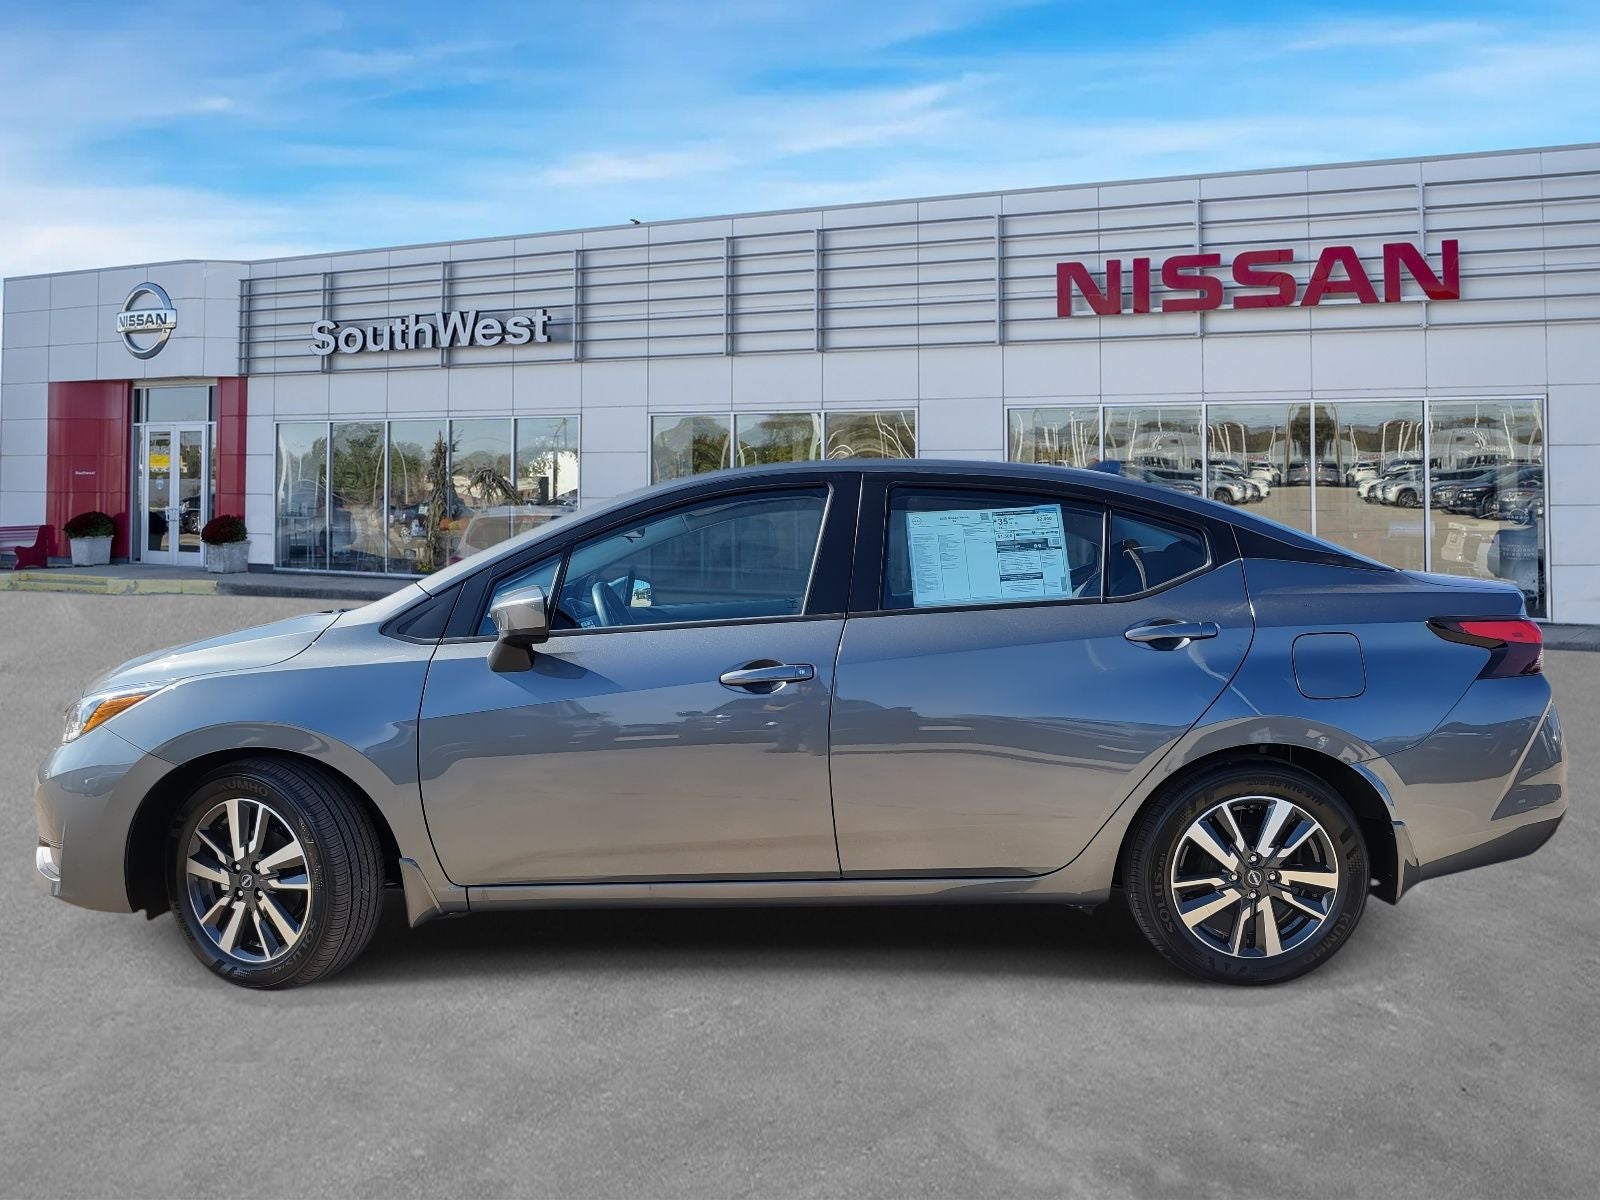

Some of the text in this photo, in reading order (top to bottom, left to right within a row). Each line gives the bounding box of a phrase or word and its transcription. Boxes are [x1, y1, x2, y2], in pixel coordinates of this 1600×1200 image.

[1057, 239, 1460, 318] NISSAN
[119, 312, 167, 328] NISSAN
[308, 309, 552, 356] SouthWest
[997, 517, 1009, 526] 35
[1154, 871, 1176, 934] SOLUS
